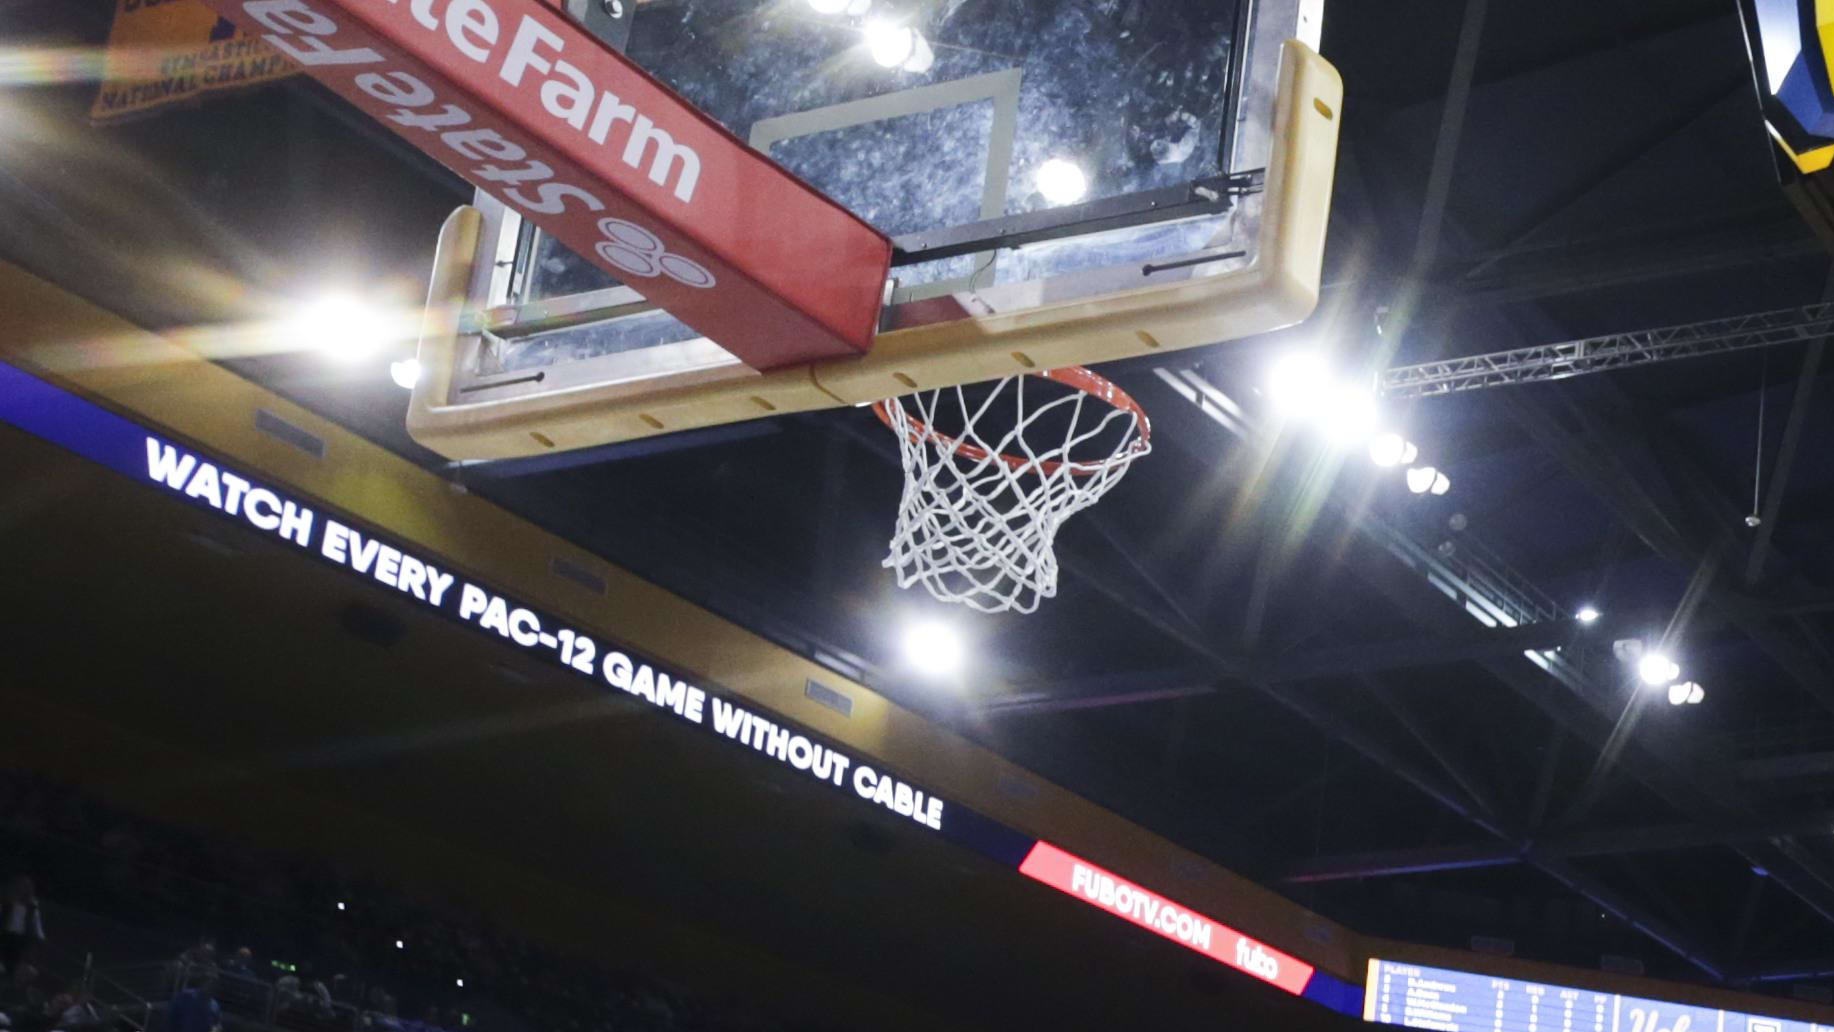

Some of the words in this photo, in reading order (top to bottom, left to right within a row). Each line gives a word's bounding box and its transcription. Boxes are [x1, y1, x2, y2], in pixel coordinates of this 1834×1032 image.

[354, 71, 605, 215] State
[499, 14, 702, 203] Farm
[146, 436, 312, 547] WATCH
[321, 520, 453, 606] EVERY
[459, 583, 594, 676] PAC-12
[602, 652, 704, 723] GAME
[711, 696, 849, 787] WITHOUT
[853, 766, 943, 831] CABLE
[1071, 864, 1210, 950] FUBOTV.COM
[1235, 936, 1279, 980] fubo
